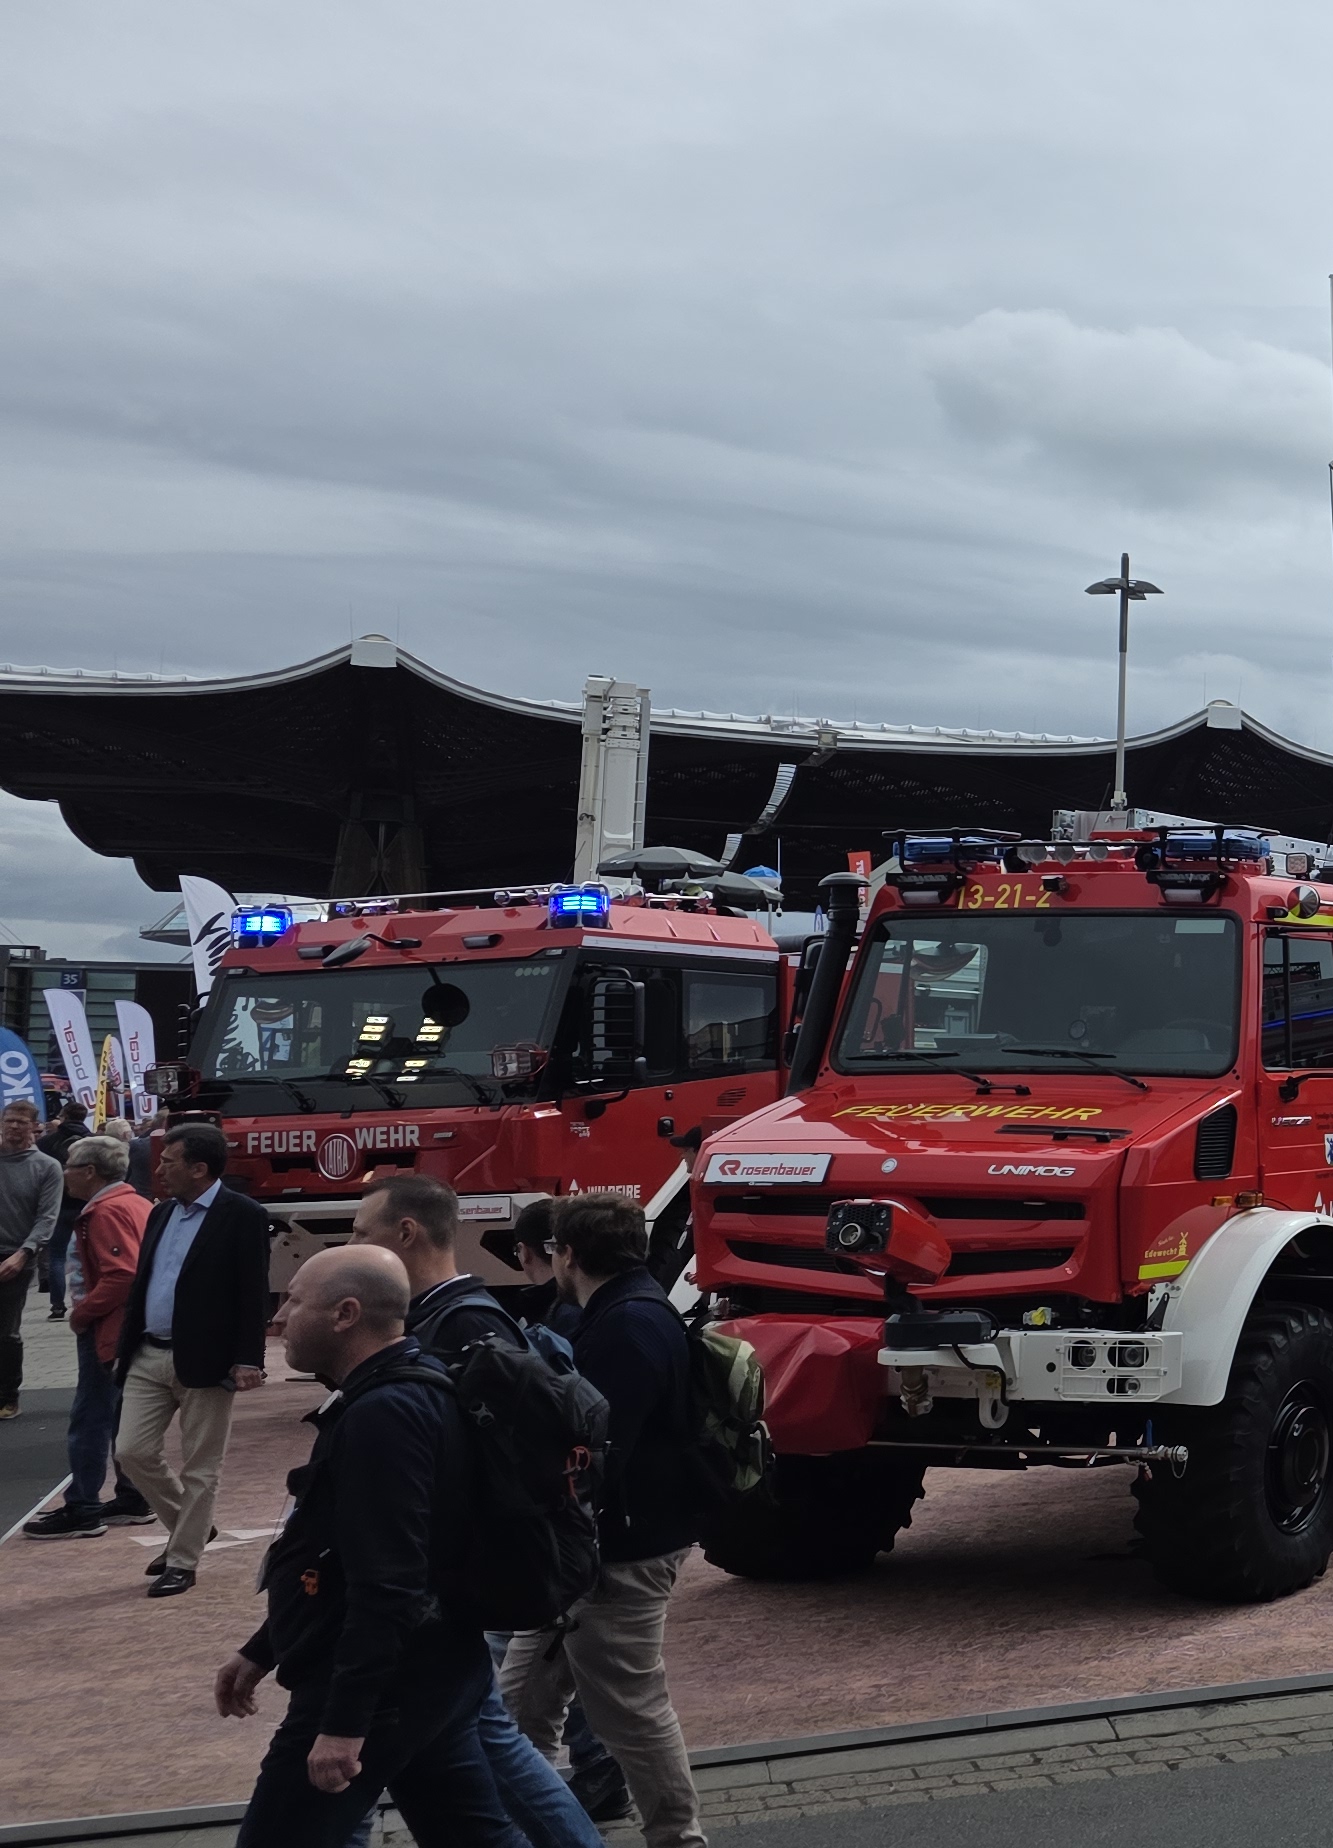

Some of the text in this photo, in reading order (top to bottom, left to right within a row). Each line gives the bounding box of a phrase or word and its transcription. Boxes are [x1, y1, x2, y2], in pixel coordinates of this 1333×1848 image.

[63, 973, 78, 985] 35
[831, 1104, 1102, 1121] FEUERWEHR
[246, 1124, 420, 1155] FEUER WEHR
[323, 1138, 349, 1177] TATRA
[740, 1162, 816, 1176] rosenbauer
[987, 1164, 1076, 1177] UNIMOG
[459, 1205, 503, 1217] senbauer
[1144, 1248, 1178, 1259] Edewecht
